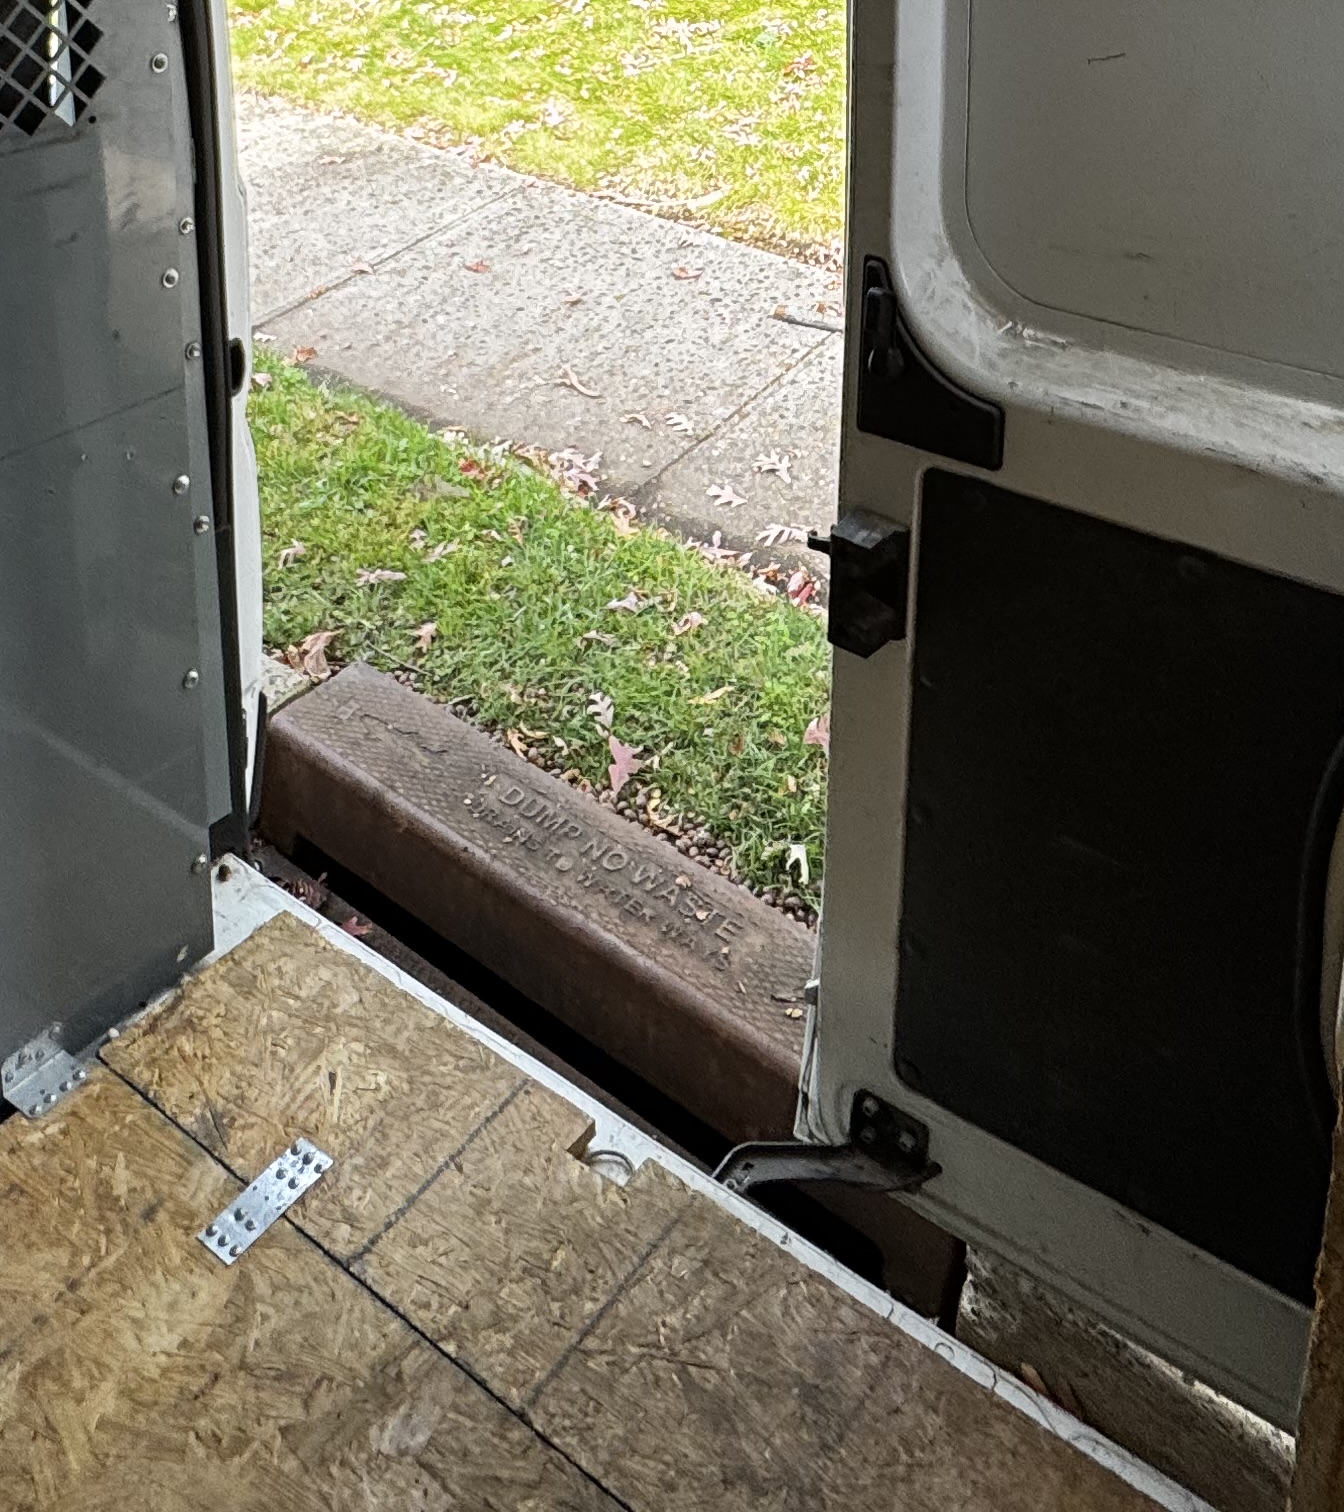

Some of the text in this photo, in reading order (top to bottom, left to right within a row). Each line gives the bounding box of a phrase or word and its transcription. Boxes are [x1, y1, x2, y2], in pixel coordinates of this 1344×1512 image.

[498, 786, 744, 944] DUMP NO WASTE
[545, 846, 574, 872] TO
